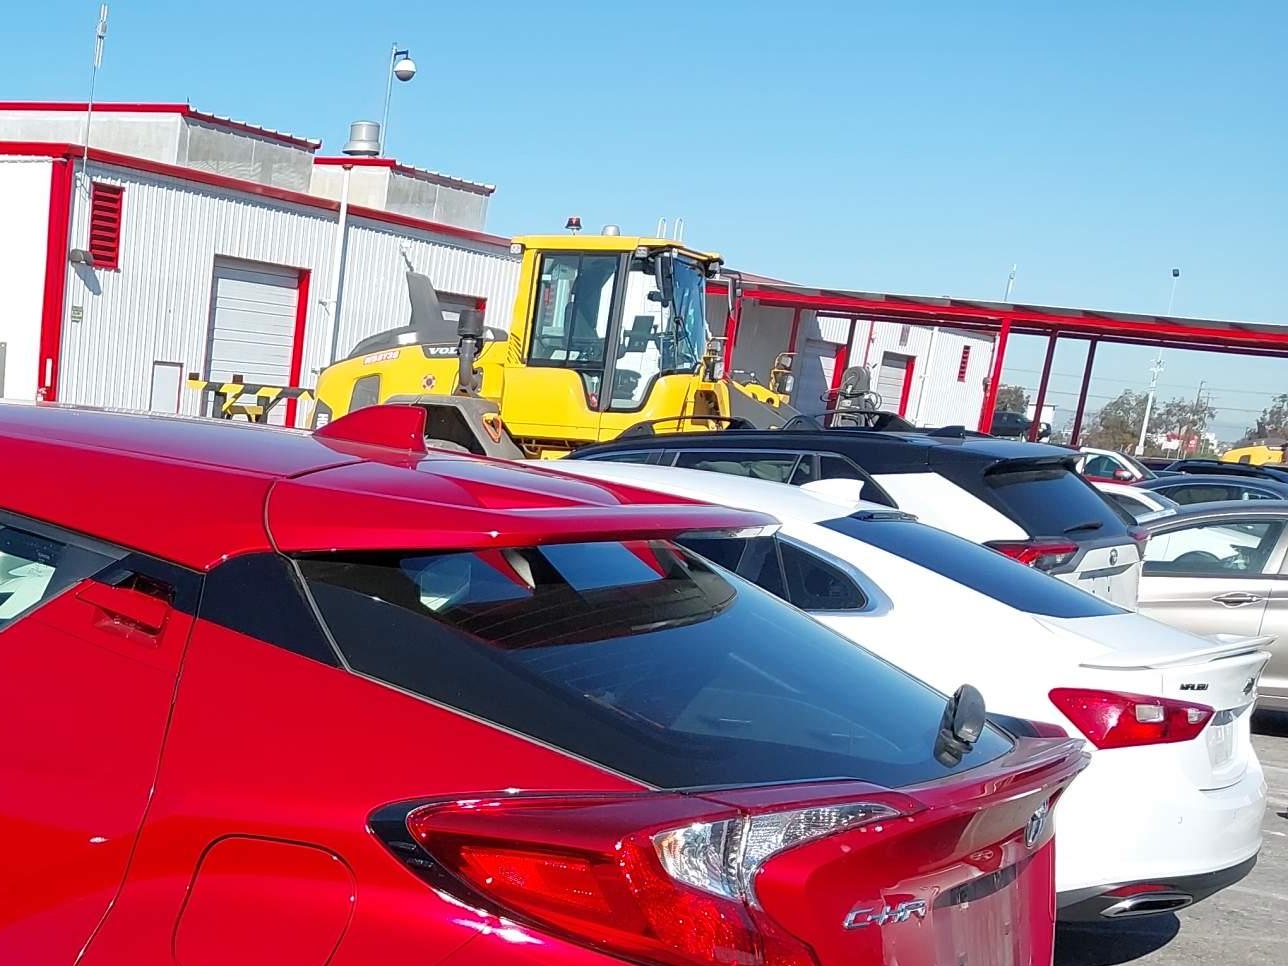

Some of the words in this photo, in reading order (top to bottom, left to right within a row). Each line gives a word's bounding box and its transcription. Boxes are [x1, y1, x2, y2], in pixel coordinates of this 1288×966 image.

[428, 346, 458, 355] VOL
[1179, 683, 1209, 691] MALIBU
[842, 898, 927, 929] C-HR
